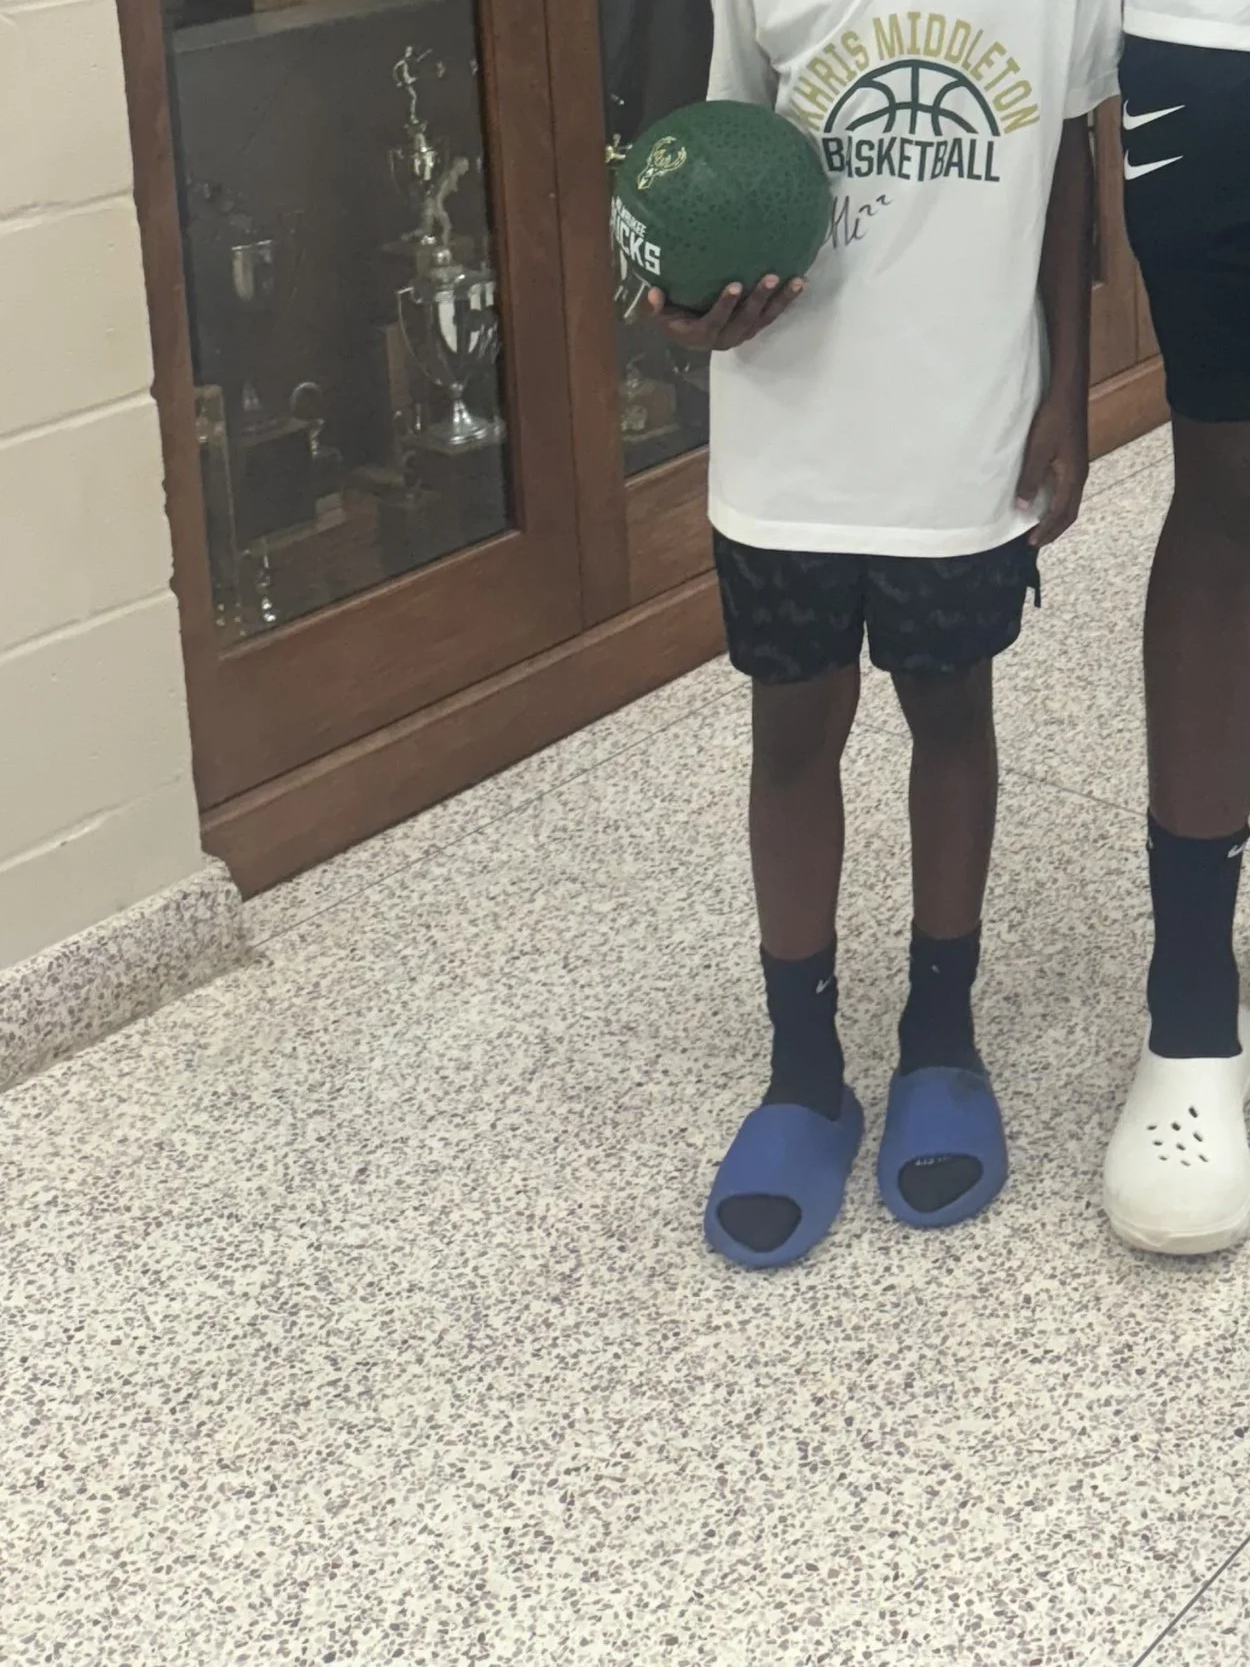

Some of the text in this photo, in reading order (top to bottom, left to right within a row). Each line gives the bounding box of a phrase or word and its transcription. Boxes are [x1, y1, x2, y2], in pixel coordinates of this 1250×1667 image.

[789, 11, 1040, 134] KHRIS MIDDLETON
[610, 214, 661, 276] CKS
